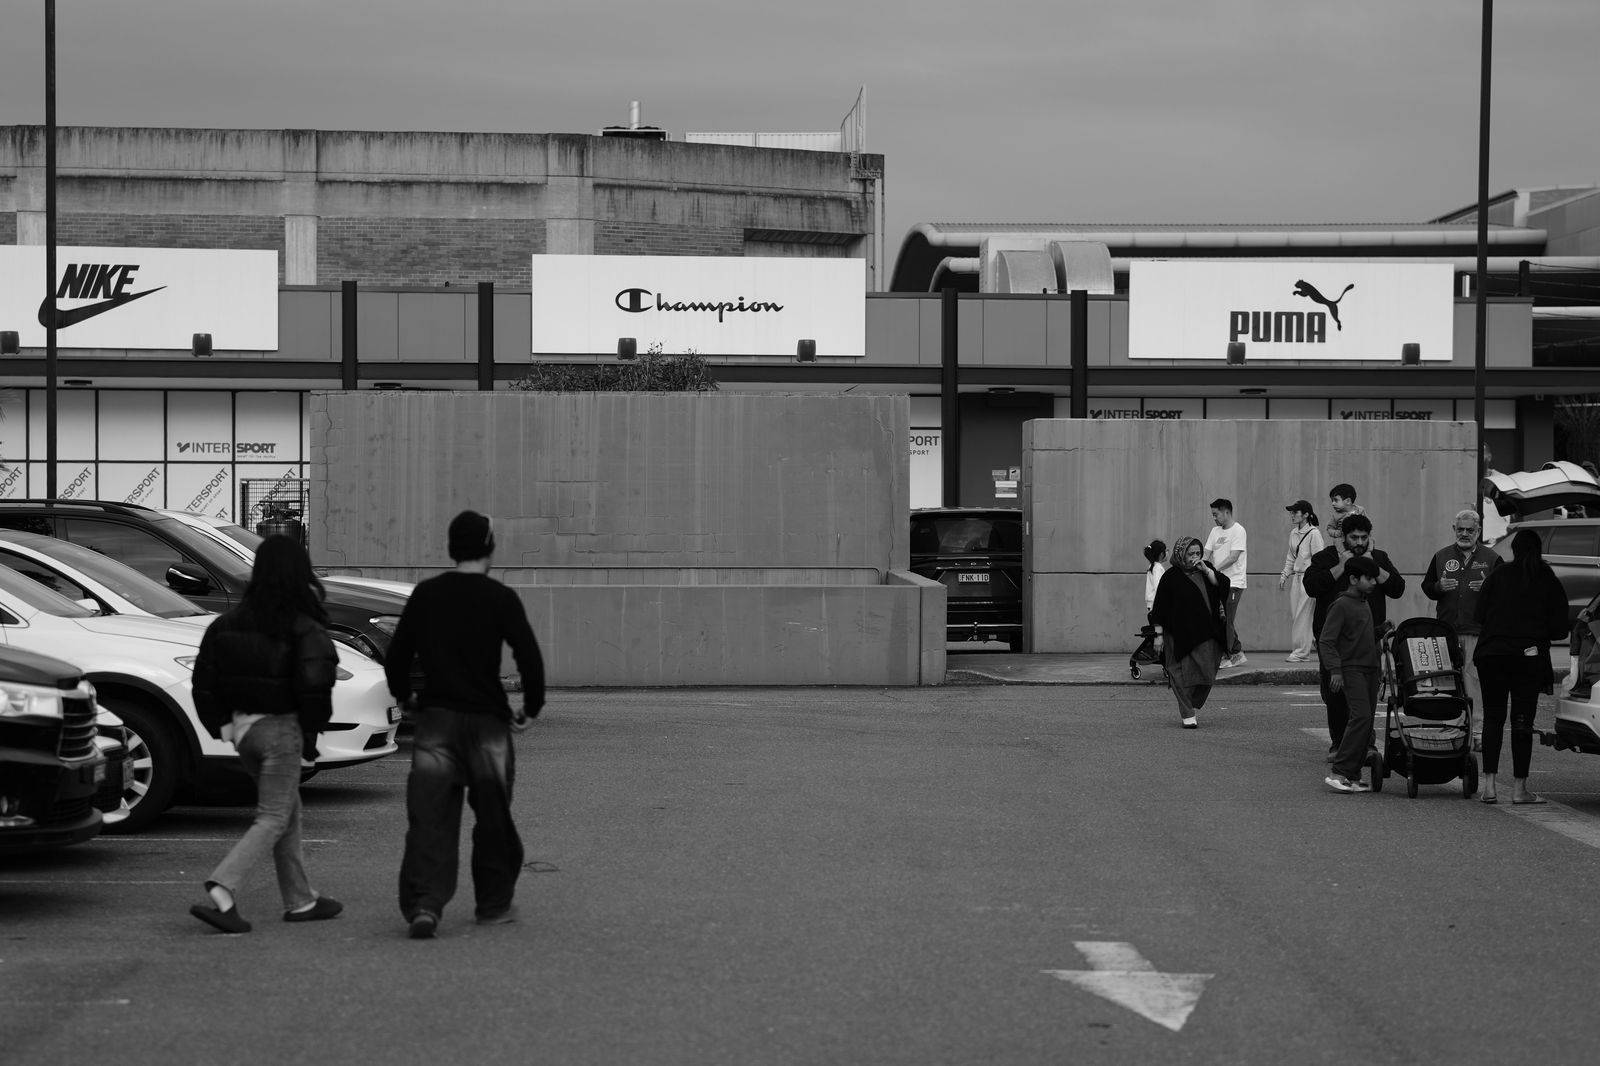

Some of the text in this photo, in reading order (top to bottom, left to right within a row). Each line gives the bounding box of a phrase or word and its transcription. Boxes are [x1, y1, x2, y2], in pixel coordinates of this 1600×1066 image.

[56, 263, 140, 299] NIKE
[615, 288, 784, 323] Champion
[1230, 311, 1326, 343] PUMA
[192, 442, 276, 454] INTER SPORT
